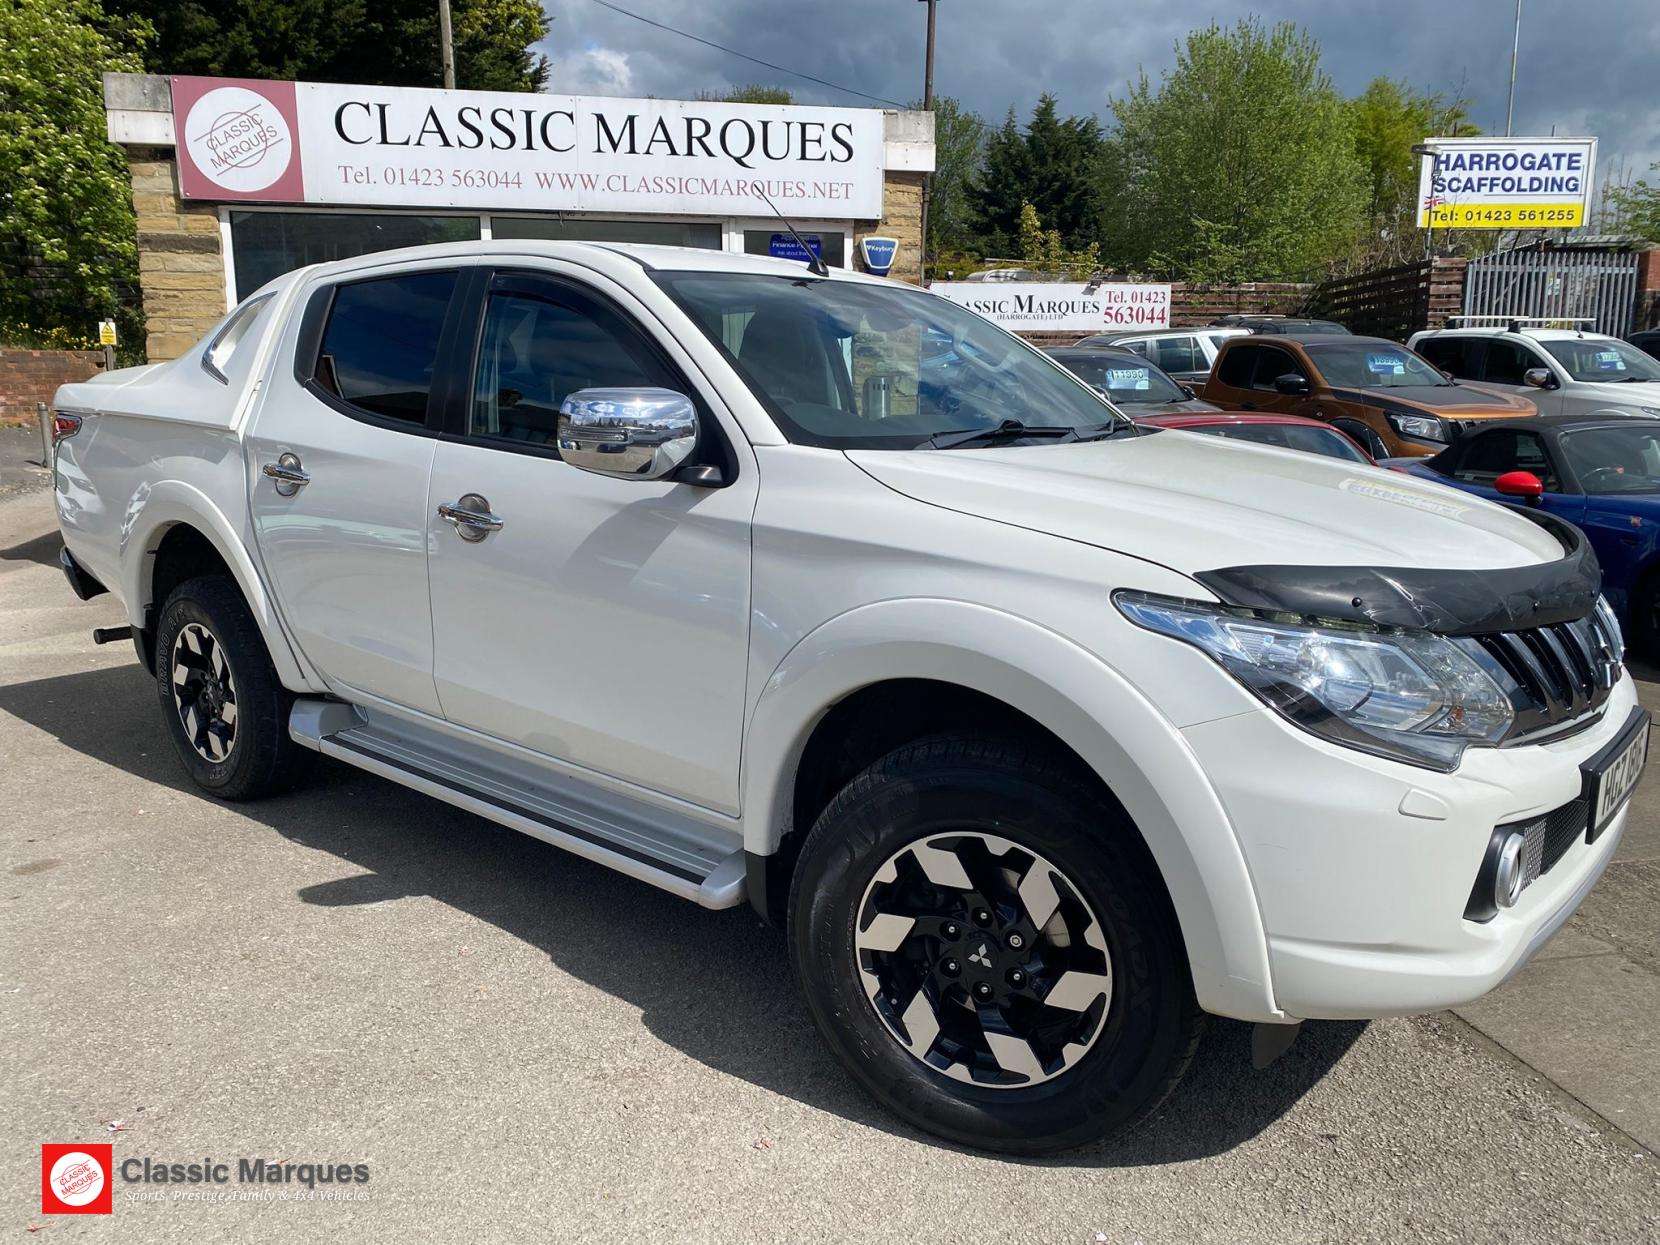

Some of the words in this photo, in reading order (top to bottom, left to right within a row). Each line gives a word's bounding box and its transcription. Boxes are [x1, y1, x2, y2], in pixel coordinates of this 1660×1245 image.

[206, 113, 263, 151] CLASSIC
[334, 101, 576, 152] CLASSIC
[591, 112, 854, 169] MARQUES
[210, 125, 278, 169] MARQUES
[1435, 152, 1582, 171] HARROGATE
[338, 165, 377, 185] Tel.
[383, 166, 444, 187] 01423
[451, 169, 523, 189] 563044
[535, 172, 854, 201] WWW.CLASSICMARQUES.NET
[1434, 176, 1579, 193] SCAFFOLDING
[1432, 210, 1458, 222] Tel:
[1465, 209, 1512, 221] 01423
[1518, 209, 1575, 221] 561255
[1014, 294, 1100, 316] MARQUES
[1106, 290, 1127, 303] Tel.
[1131, 290, 1166, 303] 01423
[1103, 306, 1166, 324] 563044
